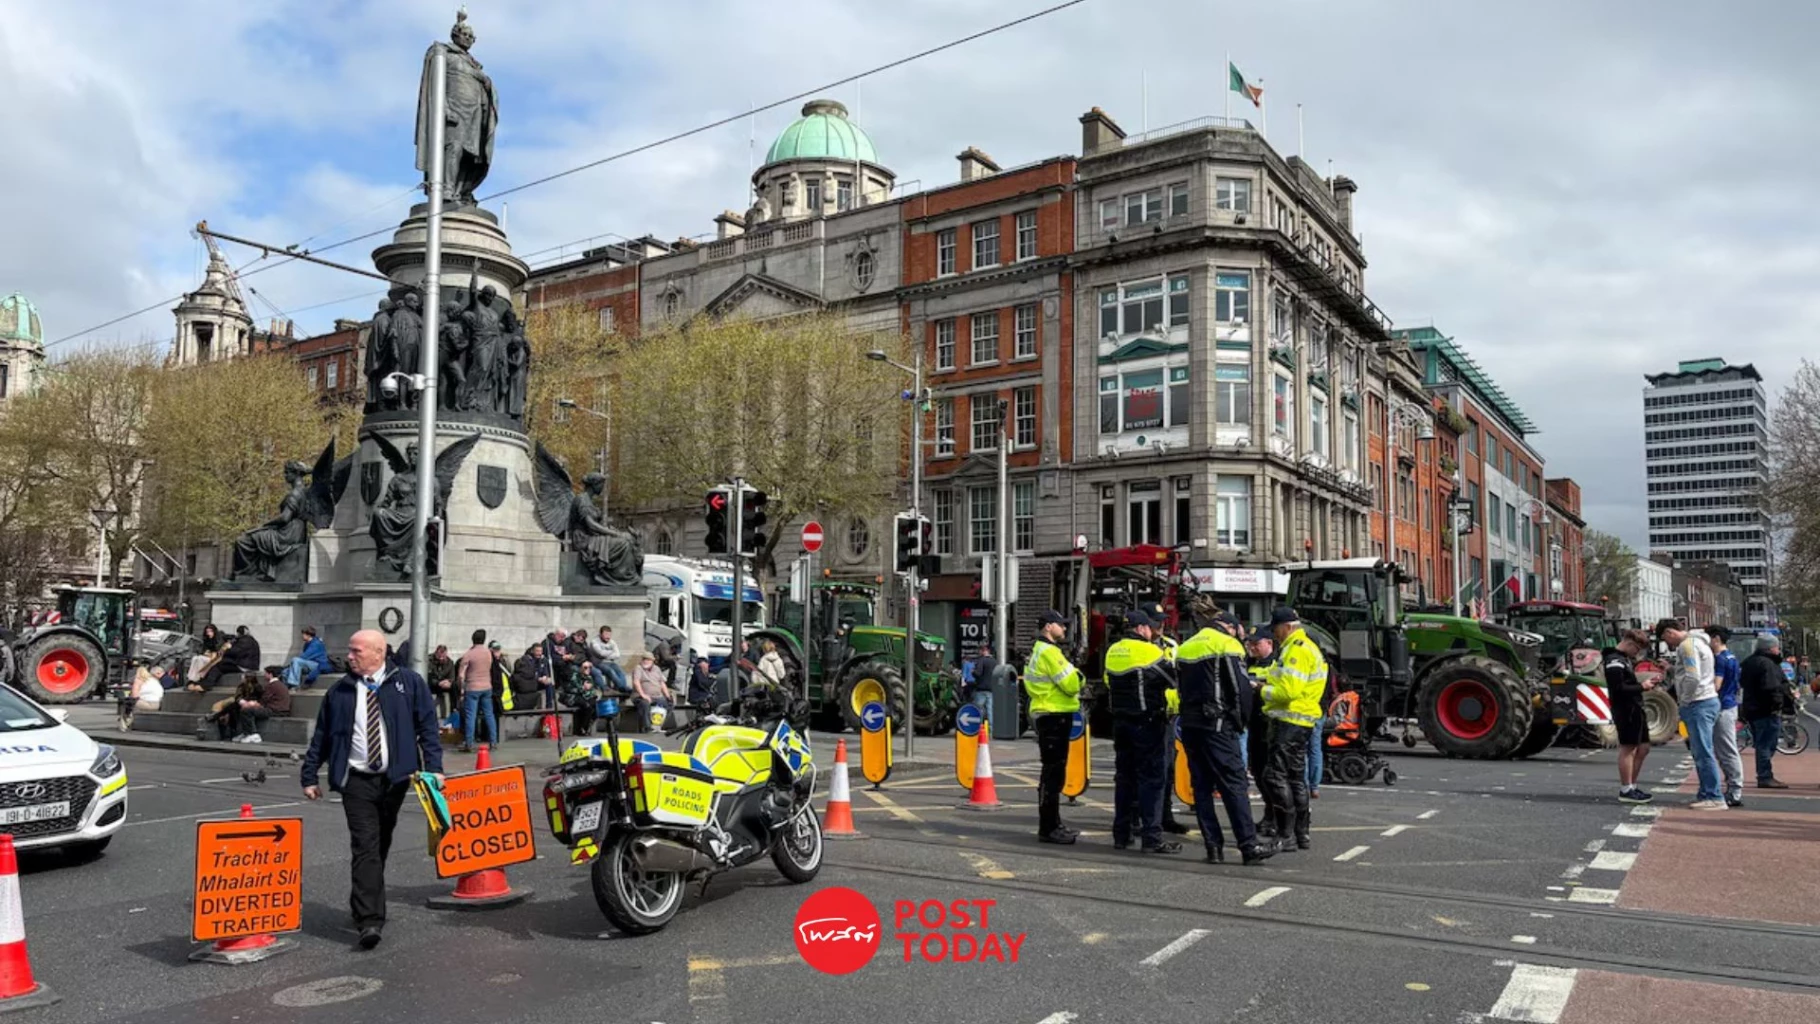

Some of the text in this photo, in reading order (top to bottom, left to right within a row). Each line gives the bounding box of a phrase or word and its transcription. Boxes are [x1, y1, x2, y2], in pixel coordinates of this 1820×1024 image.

[960, 623, 979, 637] TO
[672, 786, 702, 801] ROADS
[664, 796, 705, 813] POLICING
[451, 804, 512, 832] ROAD
[442, 830, 529, 863] CLOSED
[213, 849, 290, 868] Tracht ar
[199, 871, 273, 892] Mhalairt
[201, 891, 294, 915] DIVERTED
[211, 914, 287, 934] TRAFFIC
